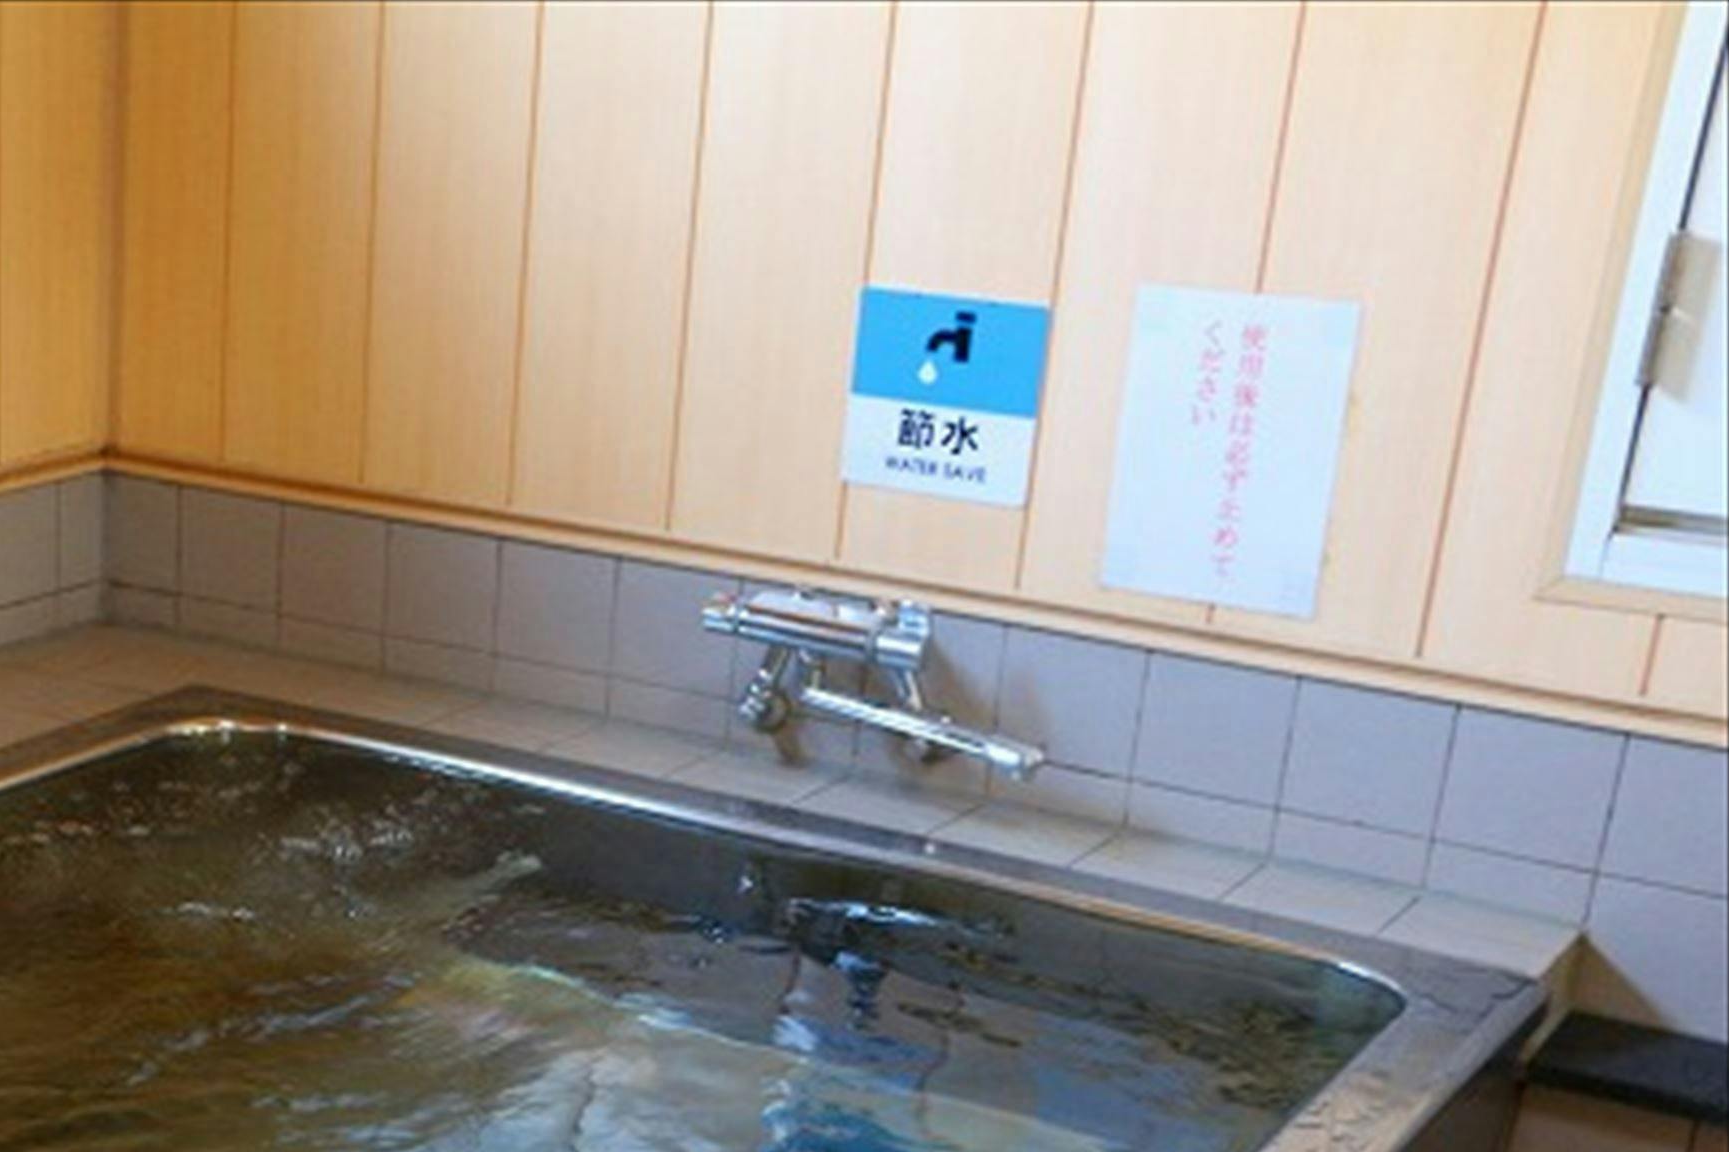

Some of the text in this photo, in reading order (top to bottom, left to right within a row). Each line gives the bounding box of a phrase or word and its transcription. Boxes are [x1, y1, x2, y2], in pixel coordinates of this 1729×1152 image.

[1190, 319, 1224, 426] ください
[897, 408, 979, 455] 節水
[885, 456, 987, 484] WATER SAVE
